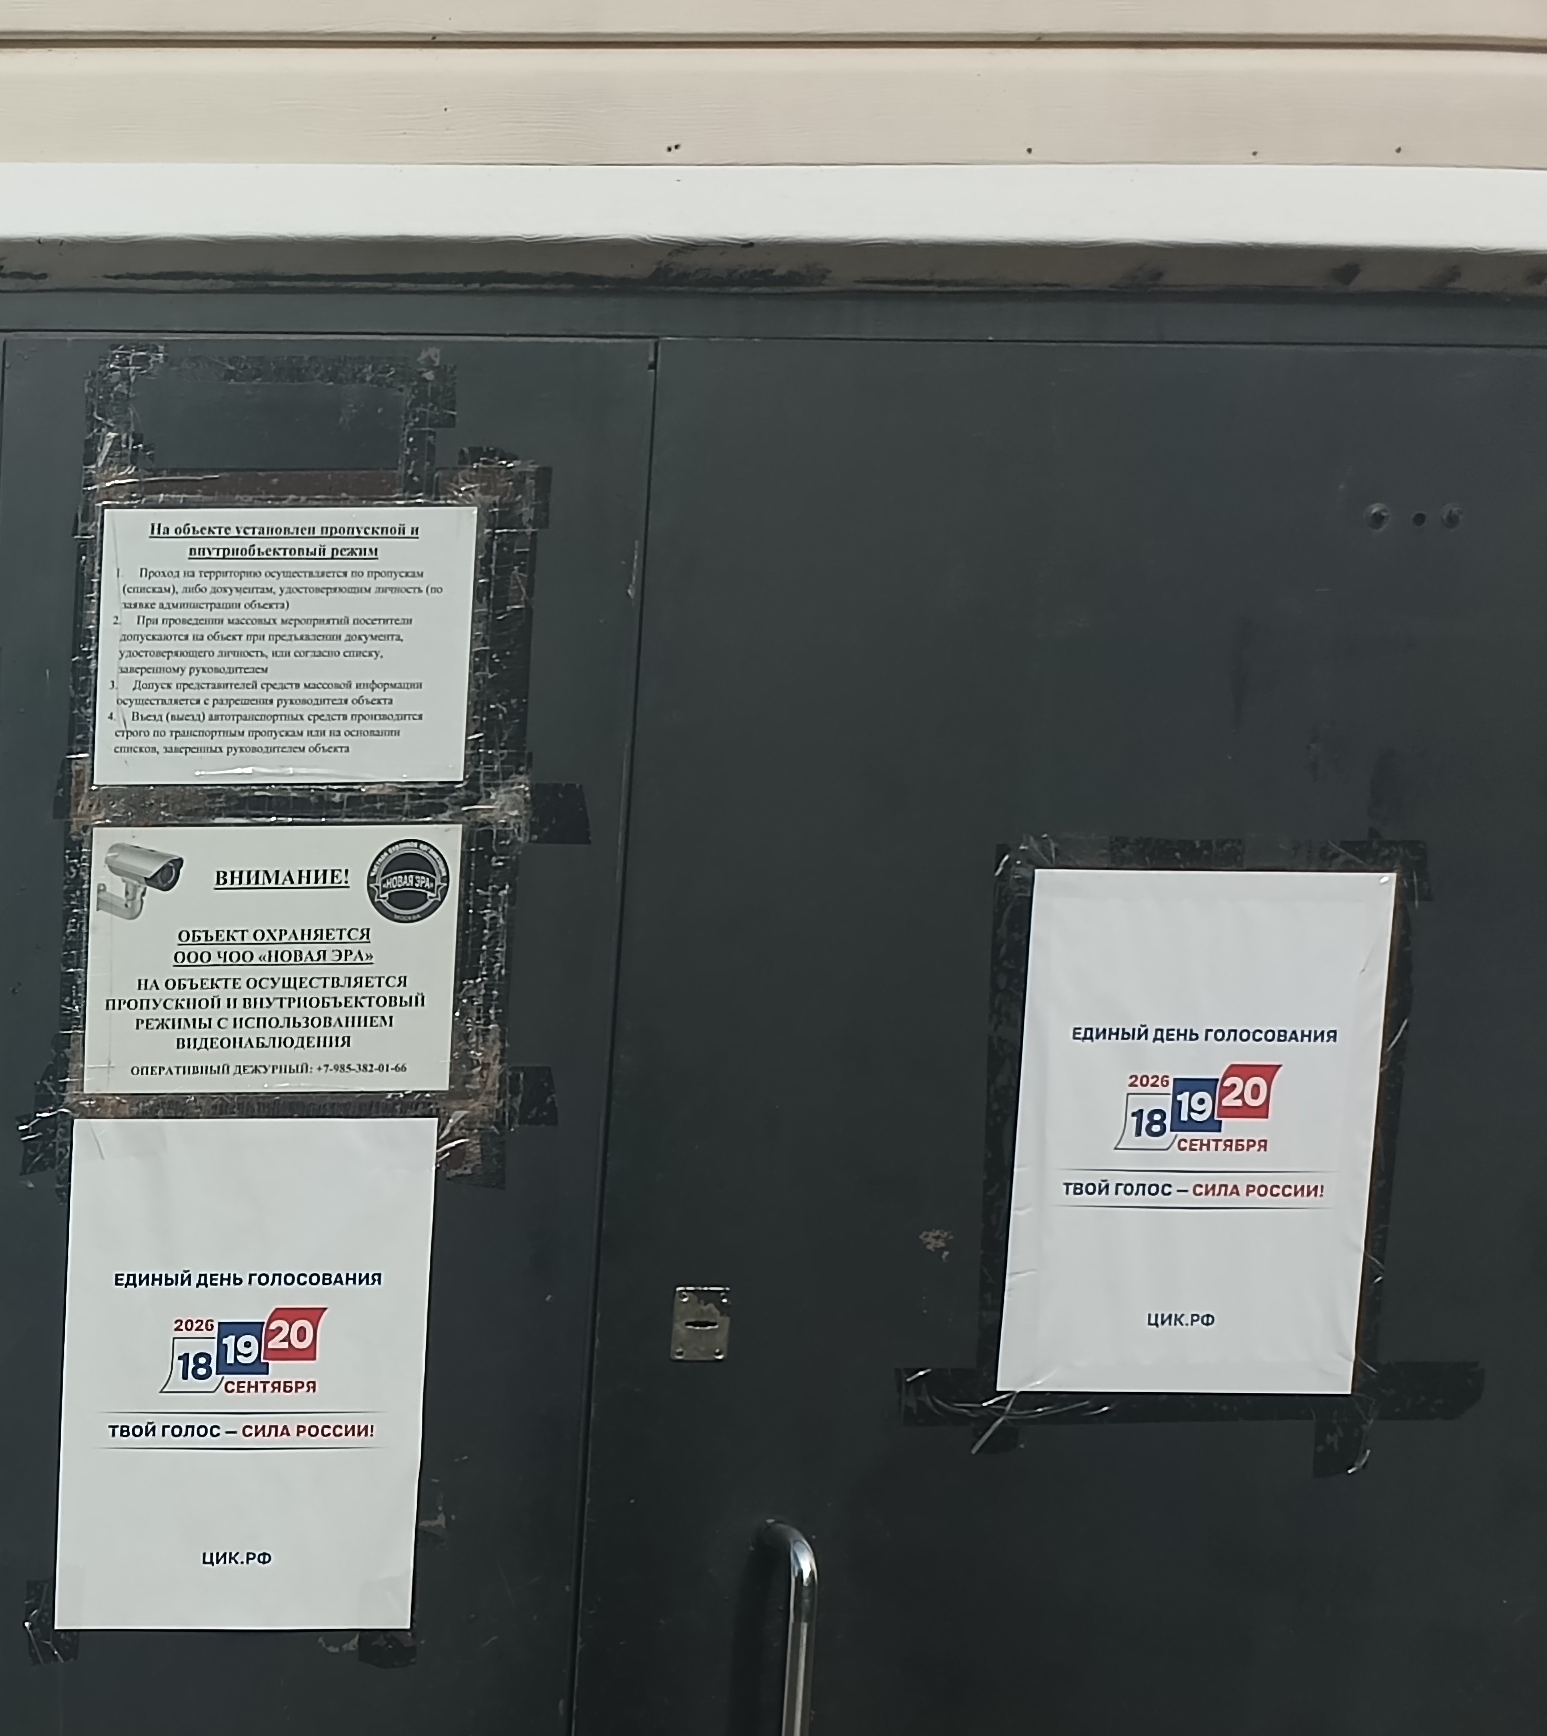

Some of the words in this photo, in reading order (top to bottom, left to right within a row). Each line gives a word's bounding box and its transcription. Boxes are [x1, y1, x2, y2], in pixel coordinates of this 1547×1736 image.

[150, 523, 170, 535] На
[174, 523, 231, 535] объекте
[235, 526, 315, 535] установлен
[321, 524, 406, 536] пропускной
[411, 527, 419, 535] и
[331, 548, 378, 558] режим
[140, 568, 180, 580] Проход
[199, 571, 261, 580] территорию
[264, 571, 348, 580] осуществляется
[367, 571, 424, 580] пропускам
[159, 602, 241, 611] администрации
[244, 600, 289, 611] объекта)
[137, 615, 158, 627] При
[162, 618, 224, 627] проведении
[281, 616, 349, 627] мероприятий
[120, 634, 188, 643] допускаются
[207, 631, 243, 641] объект
[246, 634, 265, 643] при
[268, 634, 341, 643] предъявлении
[344, 634, 403, 643] документа,
[119, 650, 214, 660] удостоверяющего
[343, 651, 384, 660] списку,
[119, 667, 186, 676] заверенному
[189, 667, 268, 676] руководителем
[132, 680, 172, 692] Допуск
[176, 681, 257, 692] представителей
[261, 682, 300, 692] средств
[304, 681, 352, 689] массовой
[356, 680, 422, 692] информации
[117, 698, 200, 707] осуществляется
[212, 698, 273, 707] разрешения
[276, 698, 348, 708] руководителя
[351, 696, 393, 705] объекта
[115, 730, 150, 739] строго
[170, 730, 244, 740] транспортным
[248, 730, 303, 739] пропускам
[114, 746, 159, 755] списков,
[163, 746, 223, 756] заверенных
[226, 746, 305, 756] руководителем
[308, 743, 350, 753] объекта
[215, 869, 349, 886] ВНИМАНИЕ!
[178, 929, 248, 942] ОБЪЕКТ
[253, 928, 370, 942] ОХРАНЯЕТСЯ
[174, 951, 212, 963] ООО
[217, 951, 254, 963] ЧОО
[258, 950, 327, 962] «НОВАЯ
[332, 949, 373, 962] ЭРА»
[137, 978, 159, 990] НА
[165, 978, 242, 990] ОБЪЕКТЕ
[246, 976, 407, 990] ОСУЩЕСТВЛЯЕТСЯ
[105, 995, 221, 1011] ПРОПУСКНОЙ
[227, 998, 237, 1009] И
[243, 992, 425, 1009] ВНУТРИОБЪЕКТОВЫЙ
[136, 1018, 212, 1030] РЕЖИМЫ
[217, 1018, 228, 1029] С
[233, 1016, 394, 1029] ИСПОЛЬЗОВАНИЕМ
[1072, 1024, 1148, 1043] ЕДИНЫЙ
[1152, 1027, 1199, 1043] ДЕНЬ
[1204, 1028, 1338, 1043] ГОЛОСОВАНИЯ
[176, 1036, 351, 1051] ВИДЕОНАБЛЮДЕНИЯ
[131, 1063, 230, 1075] ОПЕРАТИВНЫЙ
[233, 1063, 313, 1075] ДЕЖУРНЫЙ:
[1128, 1074, 1170, 1088] 2026
[1131, 1109, 1167, 1139] 18
[1176, 1091, 1212, 1122] 19
[1221, 1076, 1268, 1107] 20
[1177, 1138, 1268, 1153] СЕНТЯБРЯ
[1063, 1179, 1110, 1196] ТВОЙ
[1114, 1182, 1172, 1196] ГОЛОС
[1192, 1183, 1241, 1198] СИЛА
[1246, 1184, 1324, 1198] РОССИИ!
[114, 1269, 192, 1289] ЕДИНЫЙ
[196, 1273, 243, 1289] ДЕНЬ
[248, 1272, 383, 1287] ГОЛОСОВАНИЯ
[173, 1318, 215, 1332] 2026
[1147, 1312, 1215, 1329] ЦИК.РФ
[178, 1352, 213, 1381] 18
[223, 1334, 259, 1364] 19
[268, 1321, 313, 1350] 20
[223, 1380, 317, 1394] СЕНТЯБРЯ
[108, 1422, 156, 1438] ТВОЙ
[161, 1425, 221, 1439] ГОЛОС
[242, 1424, 291, 1438] СИЛА
[296, 1424, 375, 1438] РОССИИ!
[202, 1551, 272, 1567] ЦИК.РФ
